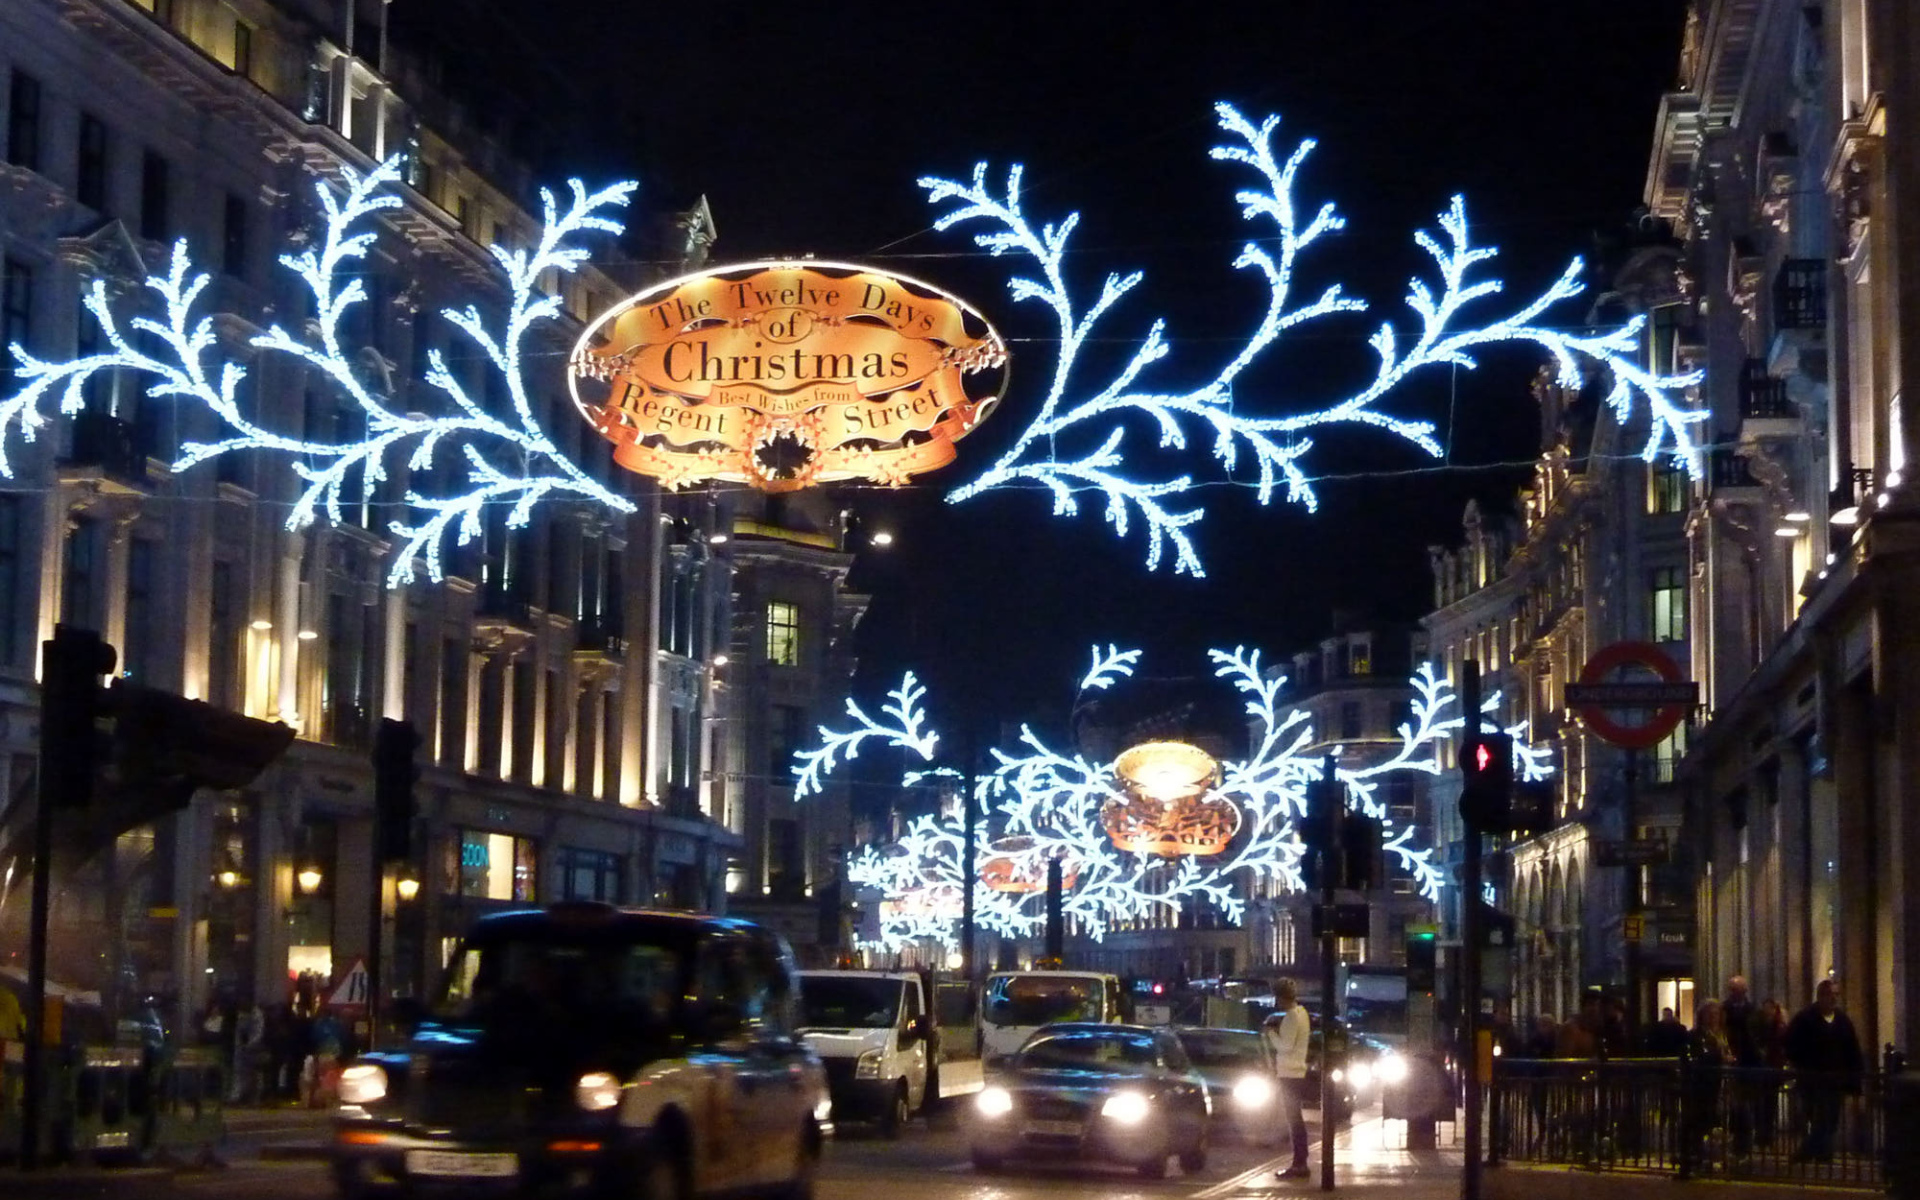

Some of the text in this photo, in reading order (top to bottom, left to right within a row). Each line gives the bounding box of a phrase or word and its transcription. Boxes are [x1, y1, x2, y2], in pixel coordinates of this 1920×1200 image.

[650, 279, 936, 332] The Twelve Days
[769, 311, 803, 338] of
[663, 340, 909, 382] Christmas
[619, 381, 944, 435] Regent Street
[719, 387, 850, 413] Best Wishes from
